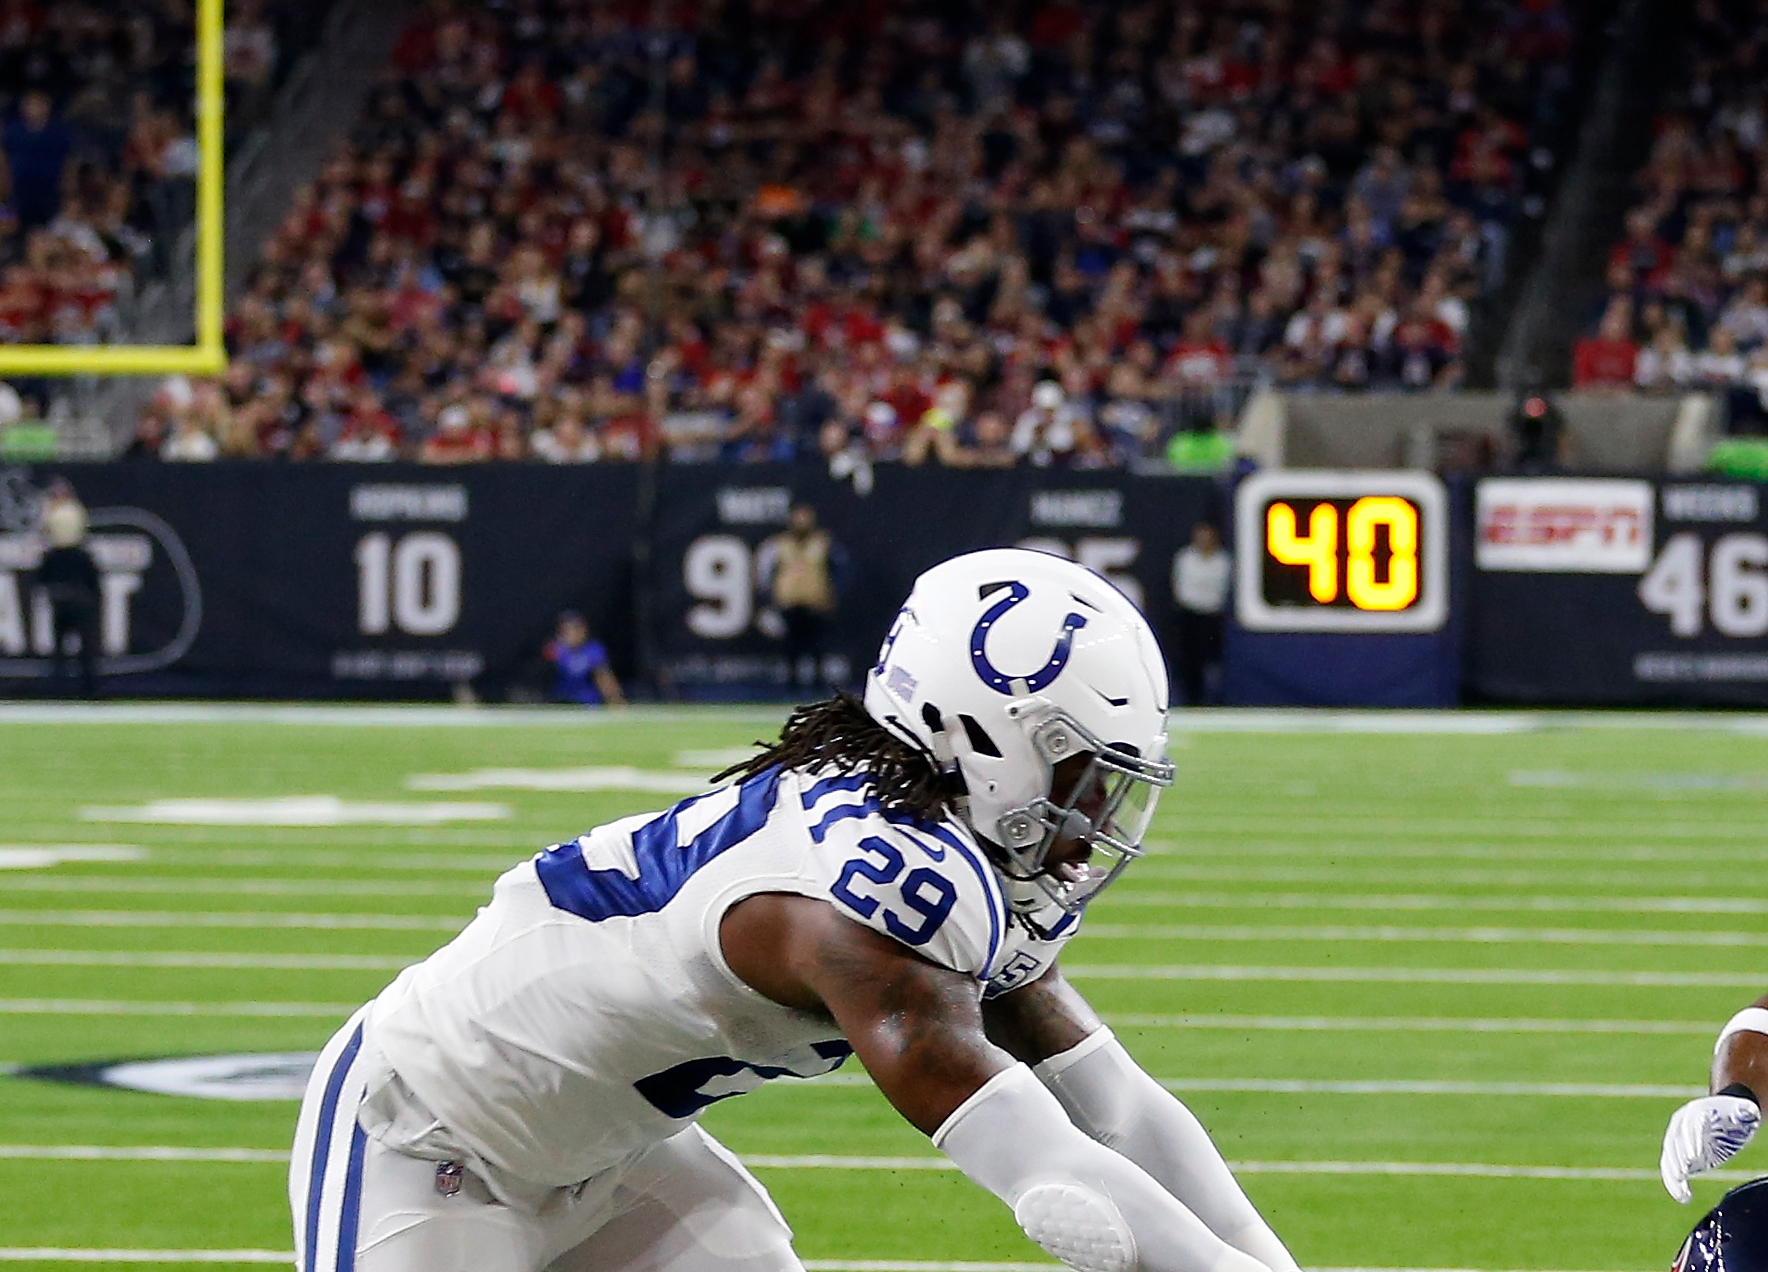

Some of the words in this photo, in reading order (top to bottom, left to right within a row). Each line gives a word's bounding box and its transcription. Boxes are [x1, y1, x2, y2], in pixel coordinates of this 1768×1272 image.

[354, 532, 463, 636] 10
[1267, 497, 1417, 611] 40
[829, 836, 957, 946] 29
